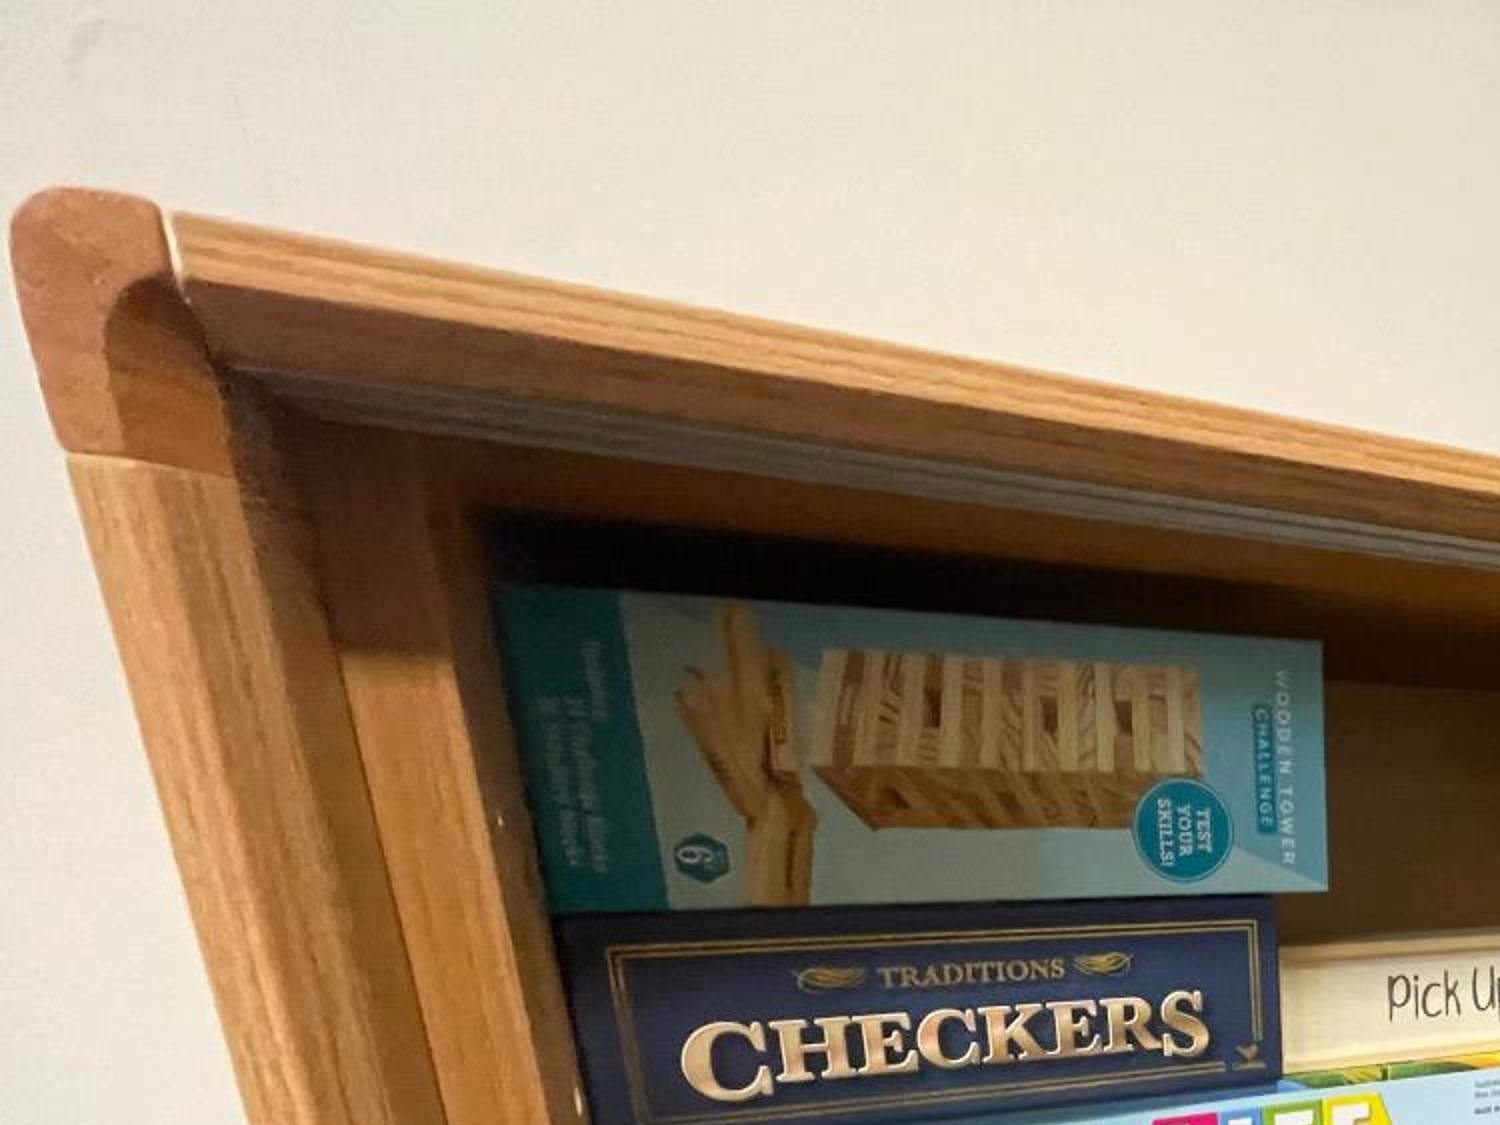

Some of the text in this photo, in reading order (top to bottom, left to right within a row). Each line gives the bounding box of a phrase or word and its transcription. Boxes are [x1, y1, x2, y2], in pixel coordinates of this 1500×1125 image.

[1254, 708, 1273, 828] CHALLENGE
[1275, 669, 1295, 865] WOODEN TOWER
[1157, 797, 1175, 867] SKILLS!
[1177, 803, 1193, 856] YOUR
[1196, 807, 1212, 854] TEST
[877, 959, 1065, 989] TRADITIONS
[681, 990, 1211, 1101] CHECKERS
